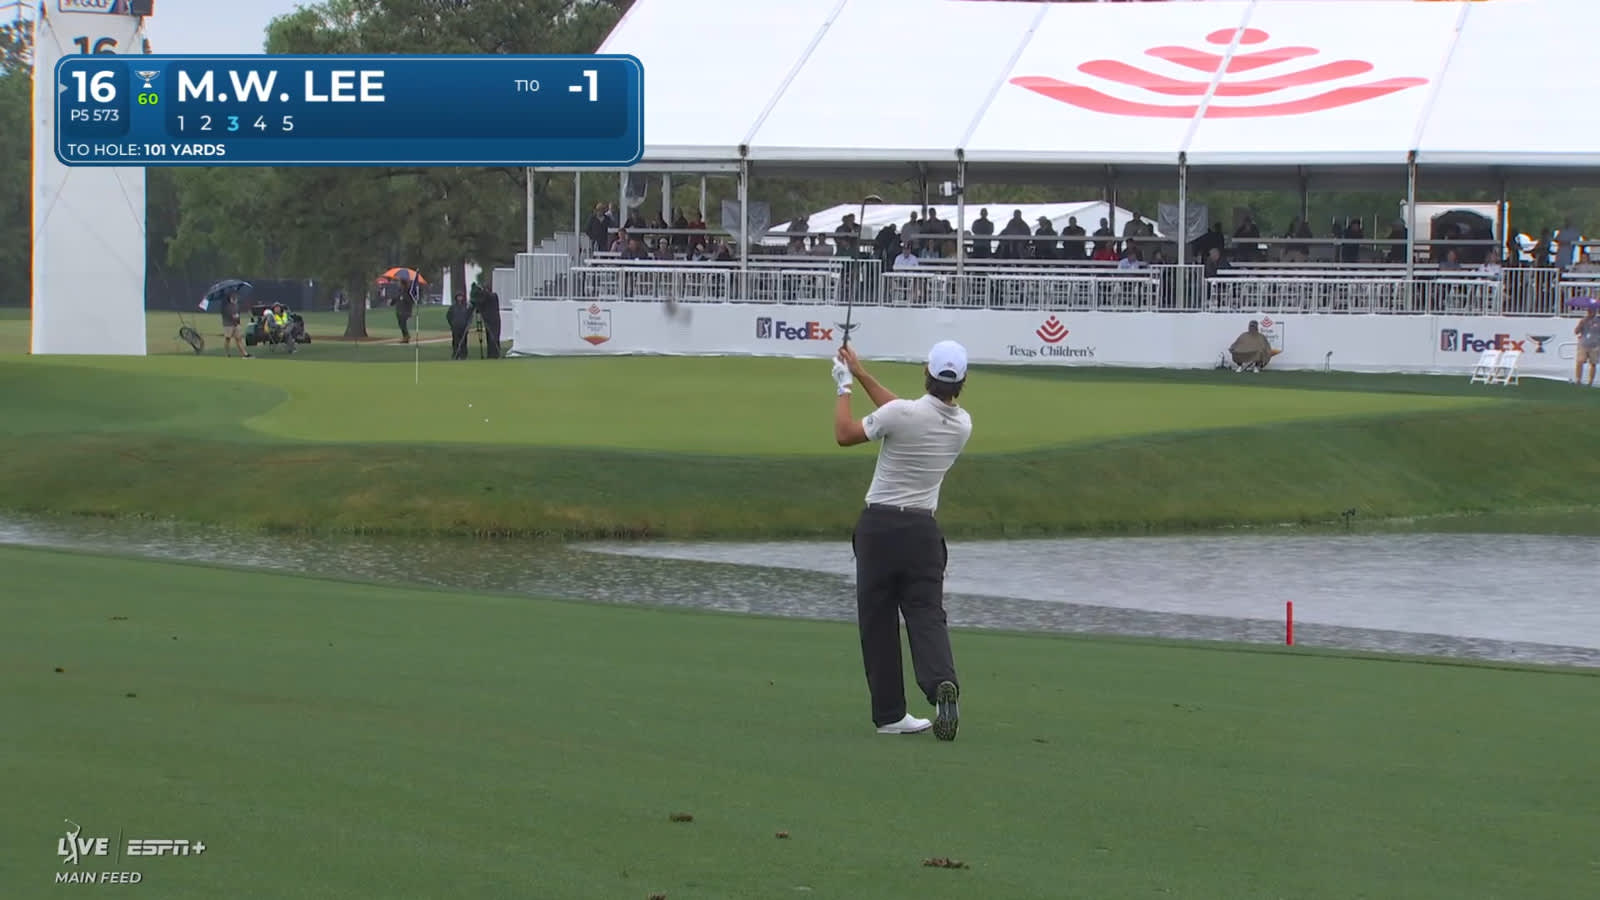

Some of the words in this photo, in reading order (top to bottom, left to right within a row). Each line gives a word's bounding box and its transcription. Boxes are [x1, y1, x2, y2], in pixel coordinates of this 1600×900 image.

[775, 321, 833, 341] FedEx
[1008, 345, 1037, 357] Texas
[1039, 345, 1096, 357] Children's
[1461, 333, 1526, 353] FedEx
